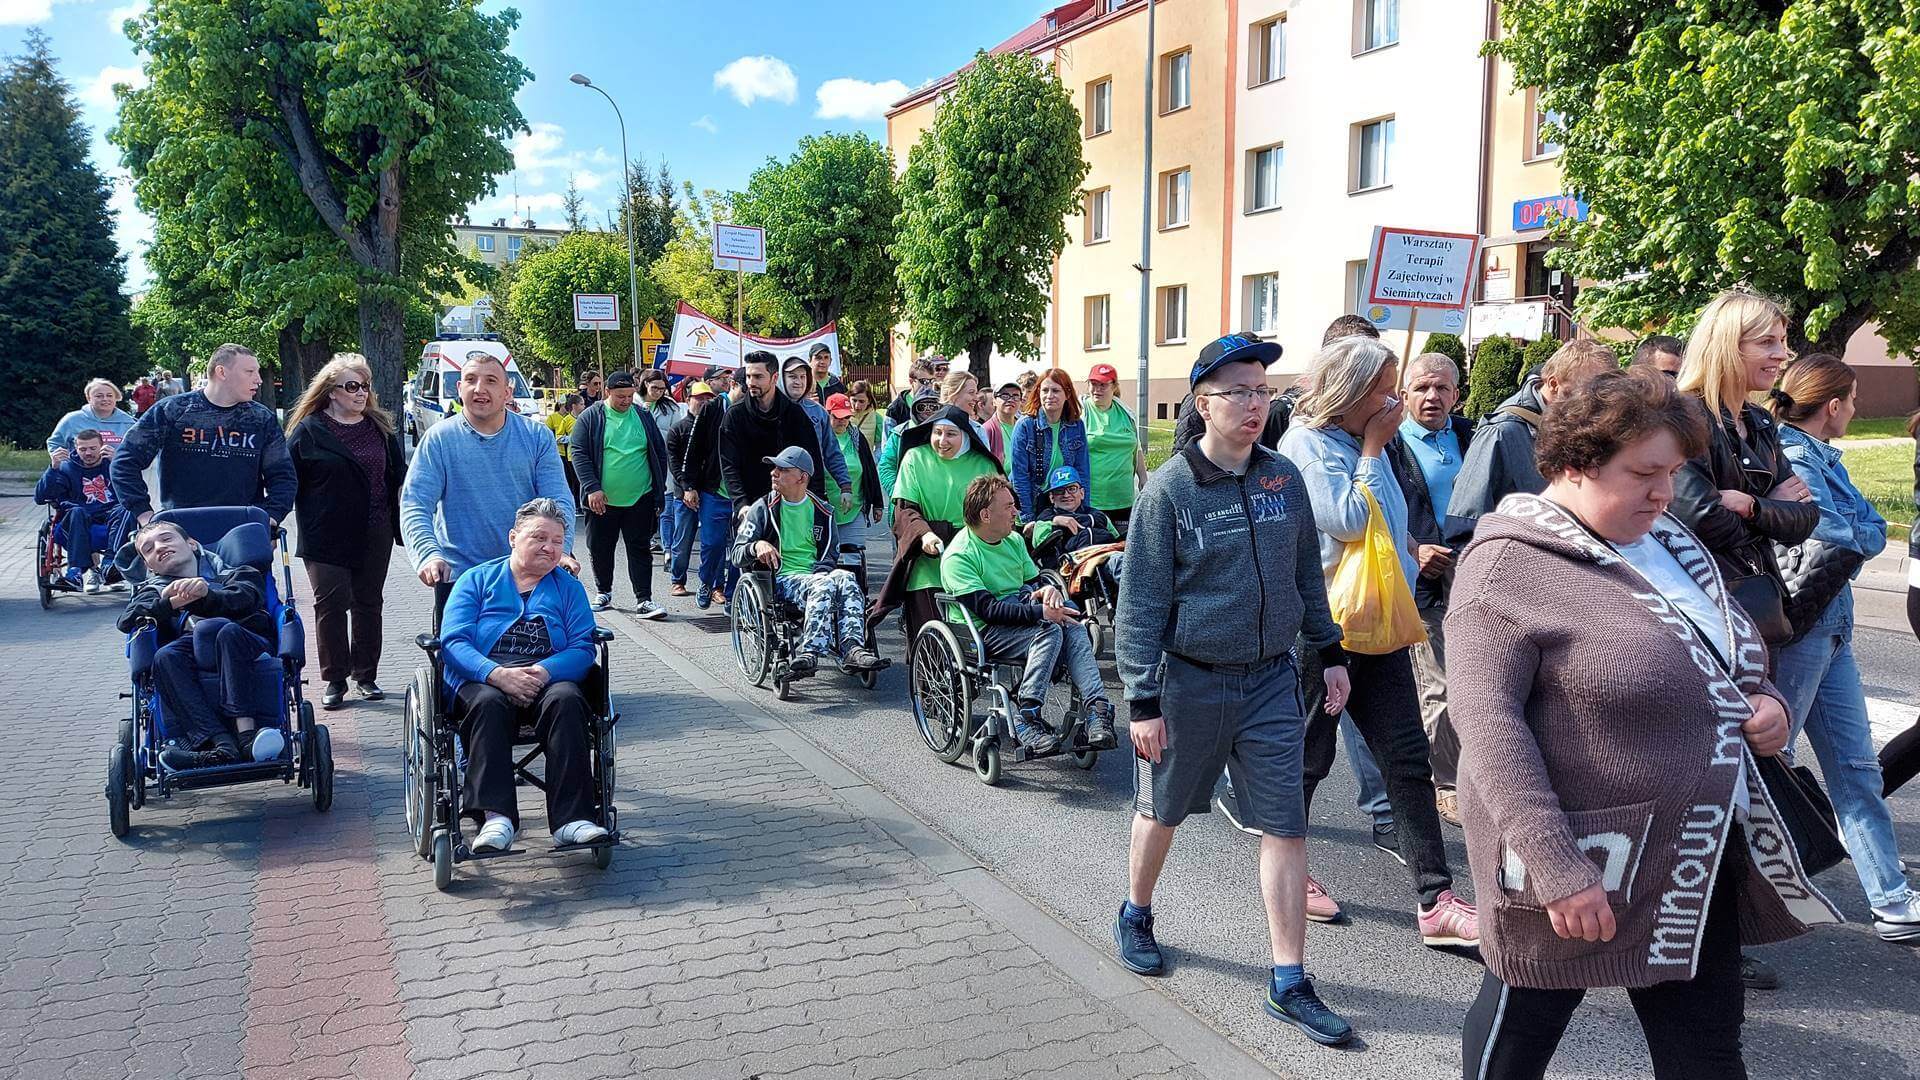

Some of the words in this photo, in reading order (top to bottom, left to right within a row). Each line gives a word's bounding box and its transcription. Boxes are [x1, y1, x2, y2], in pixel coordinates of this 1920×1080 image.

[1402, 235, 1455, 252] Warsztaty
[1406, 253, 1444, 268] Terapii
[1387, 269, 1444, 286] Zajęciowej
[1446, 276, 1455, 284] w
[1381, 286, 1454, 302] Siemiatyczach
[182, 426, 257, 450] BLACK
[1647, 803, 1727, 967] minouu
